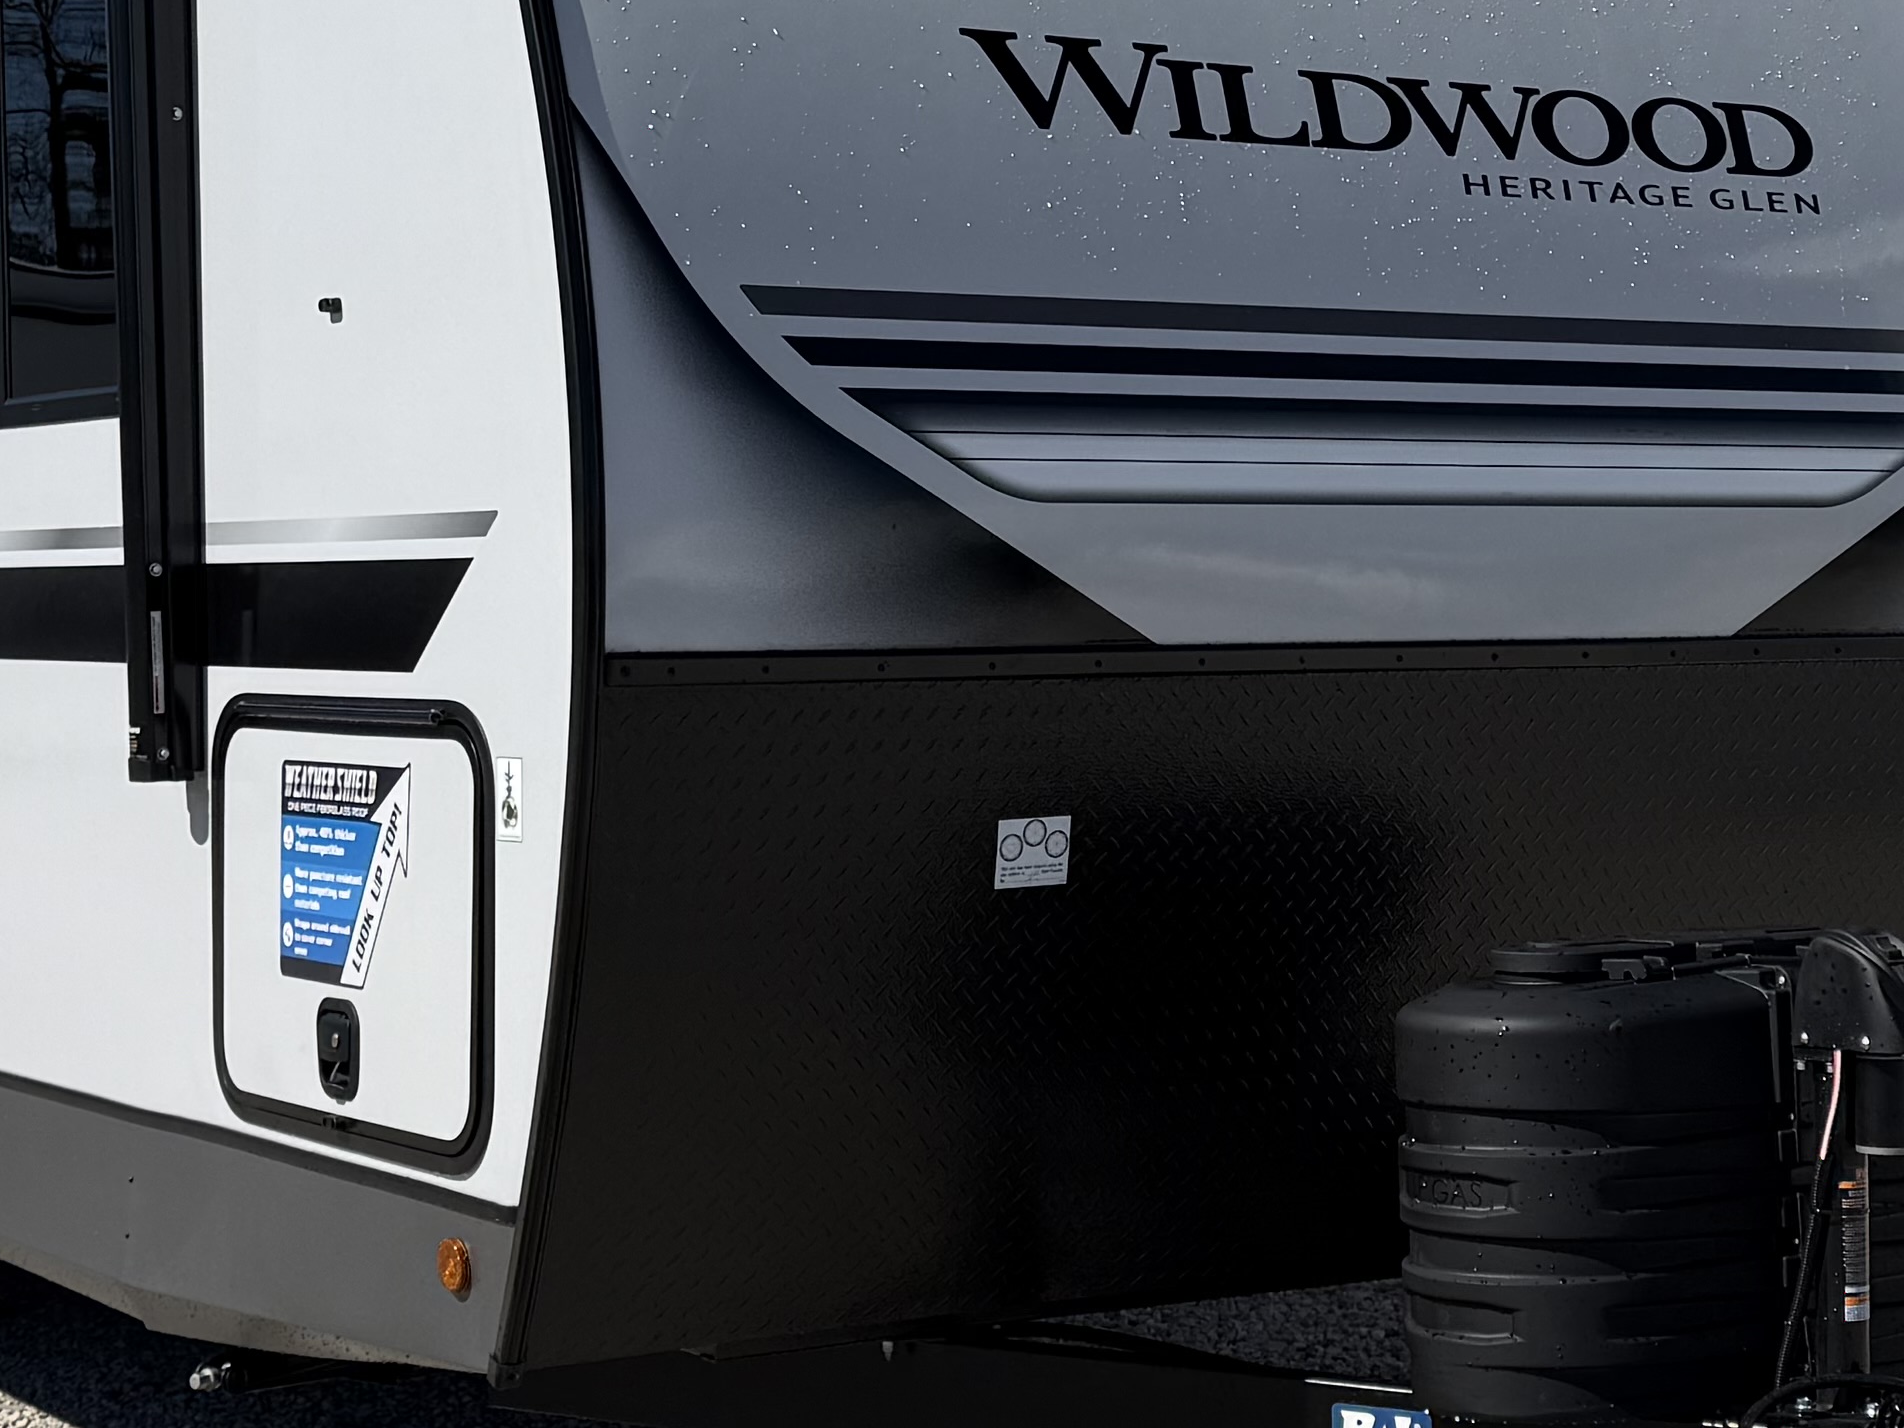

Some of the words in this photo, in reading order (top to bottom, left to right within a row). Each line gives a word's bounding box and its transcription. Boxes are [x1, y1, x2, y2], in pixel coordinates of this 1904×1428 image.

[958, 27, 1815, 178] WILDWOOD
[1462, 173, 1694, 209] HERITAGE
[1709, 188, 1821, 215] GLEN
[352, 907, 374, 974] LOOK
[370, 865, 383, 903] UP
[381, 802, 402, 859] TOP!
[1432, 1178, 1483, 1207] GAS
